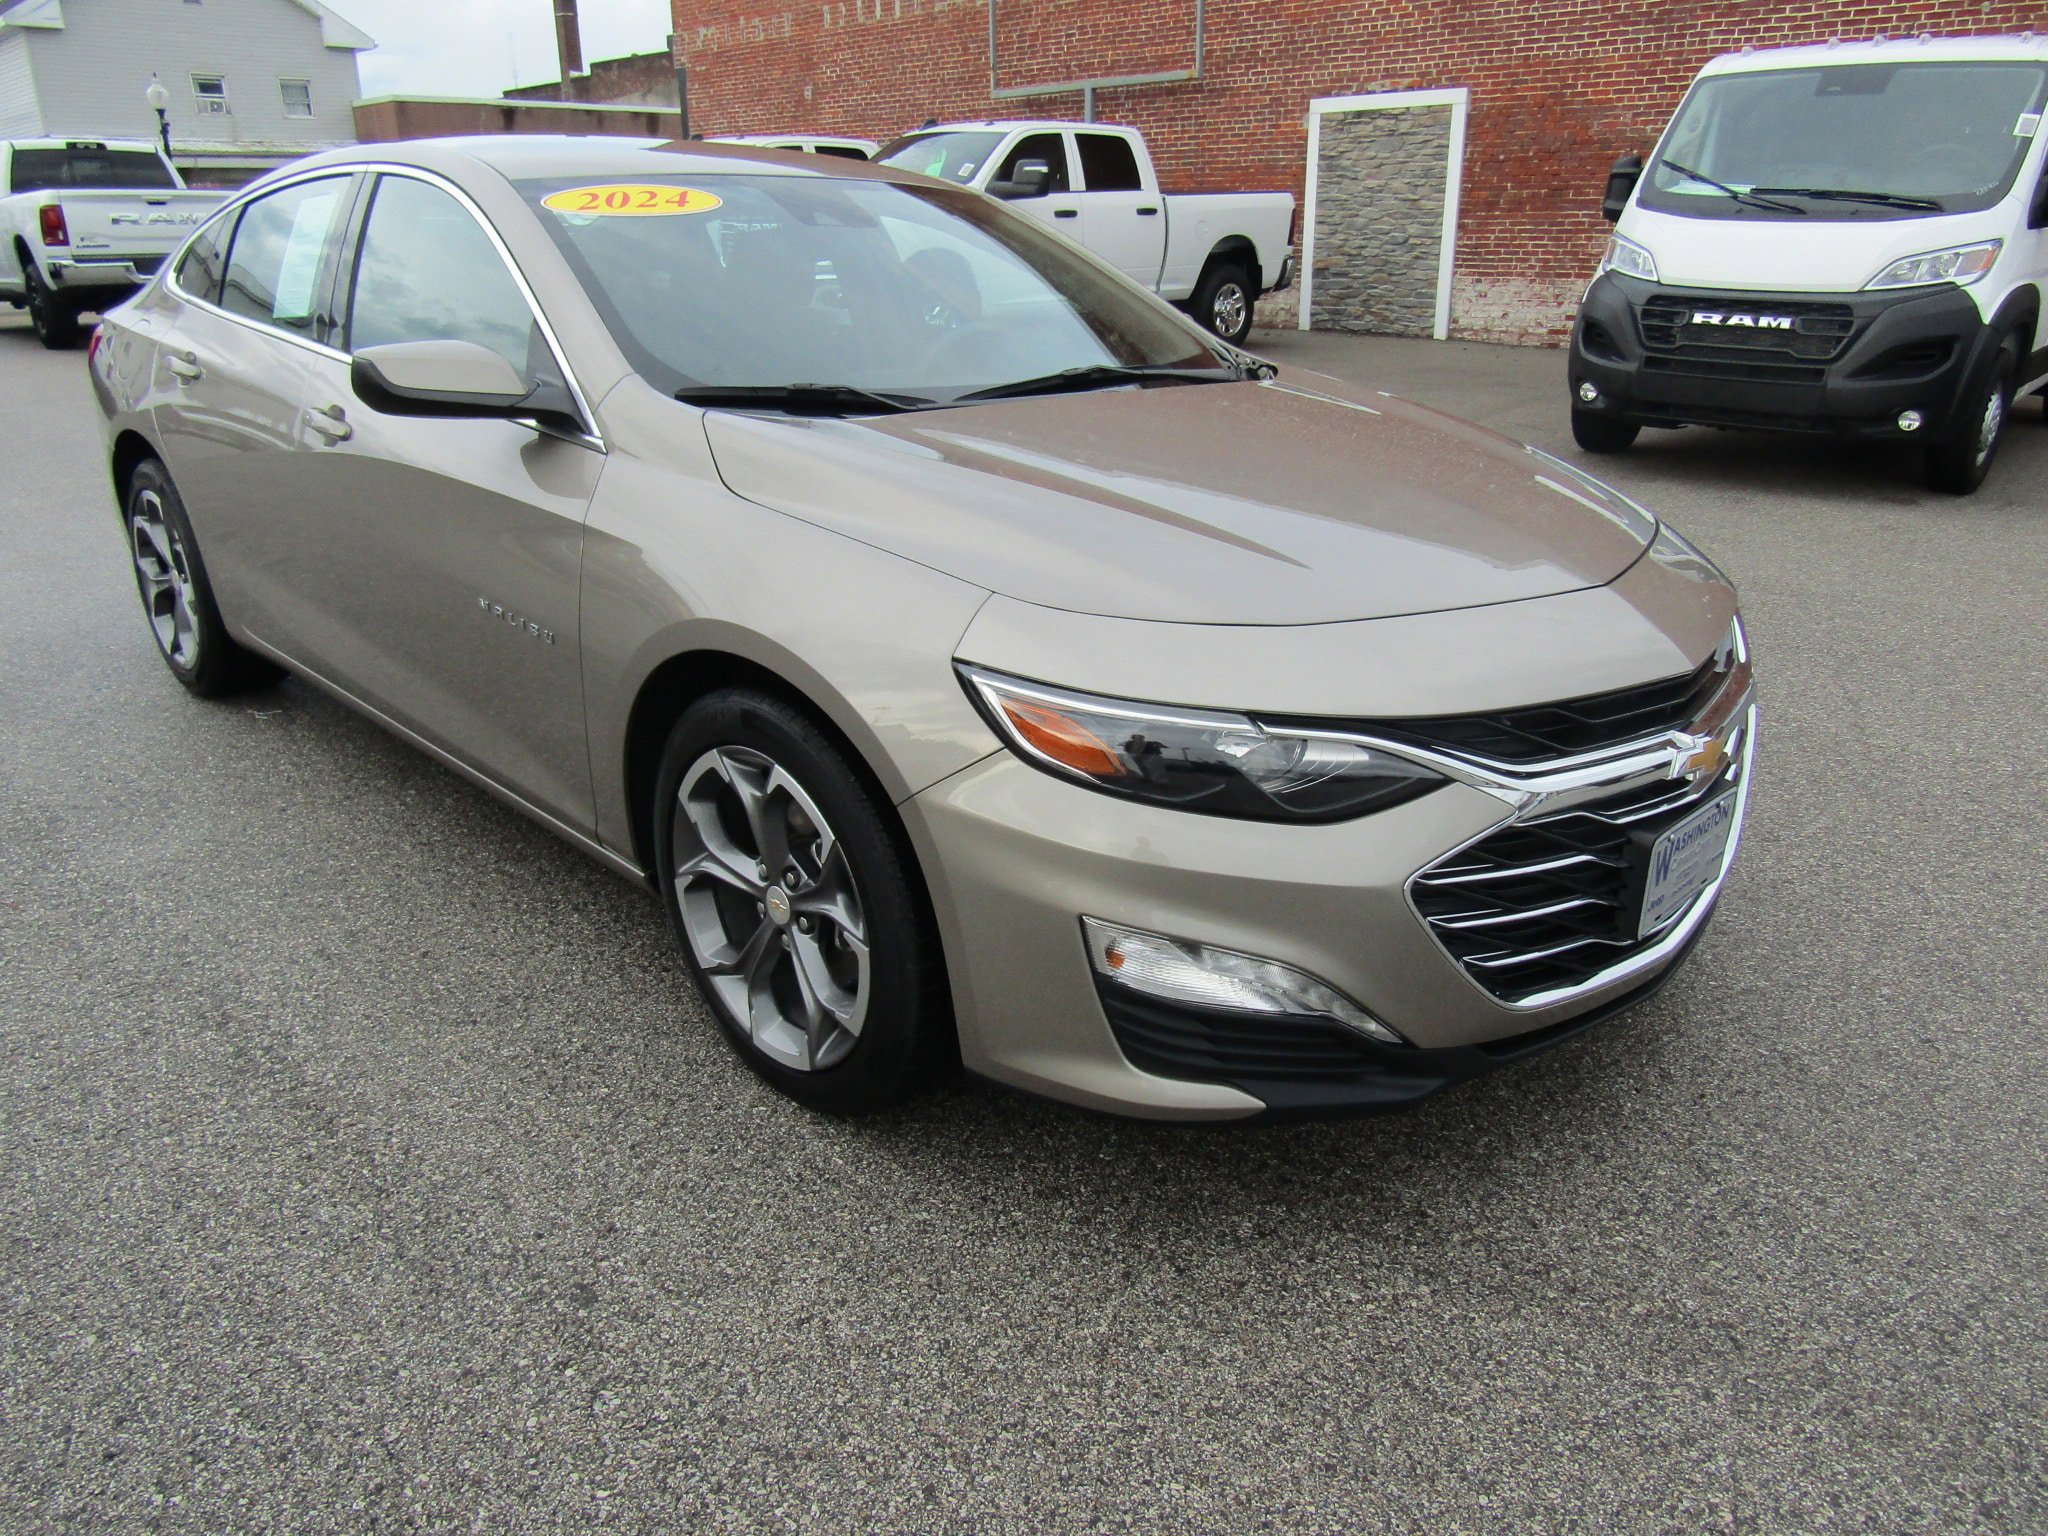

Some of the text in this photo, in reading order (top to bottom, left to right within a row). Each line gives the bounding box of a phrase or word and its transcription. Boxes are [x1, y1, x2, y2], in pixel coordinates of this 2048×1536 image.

[576, 190, 690, 211] 2024
[110, 212, 207, 226] RAM
[1692, 312, 1793, 330] RAM
[479, 598, 555, 645] MALIBU
[1654, 803, 1731, 887] WASHINGTON
